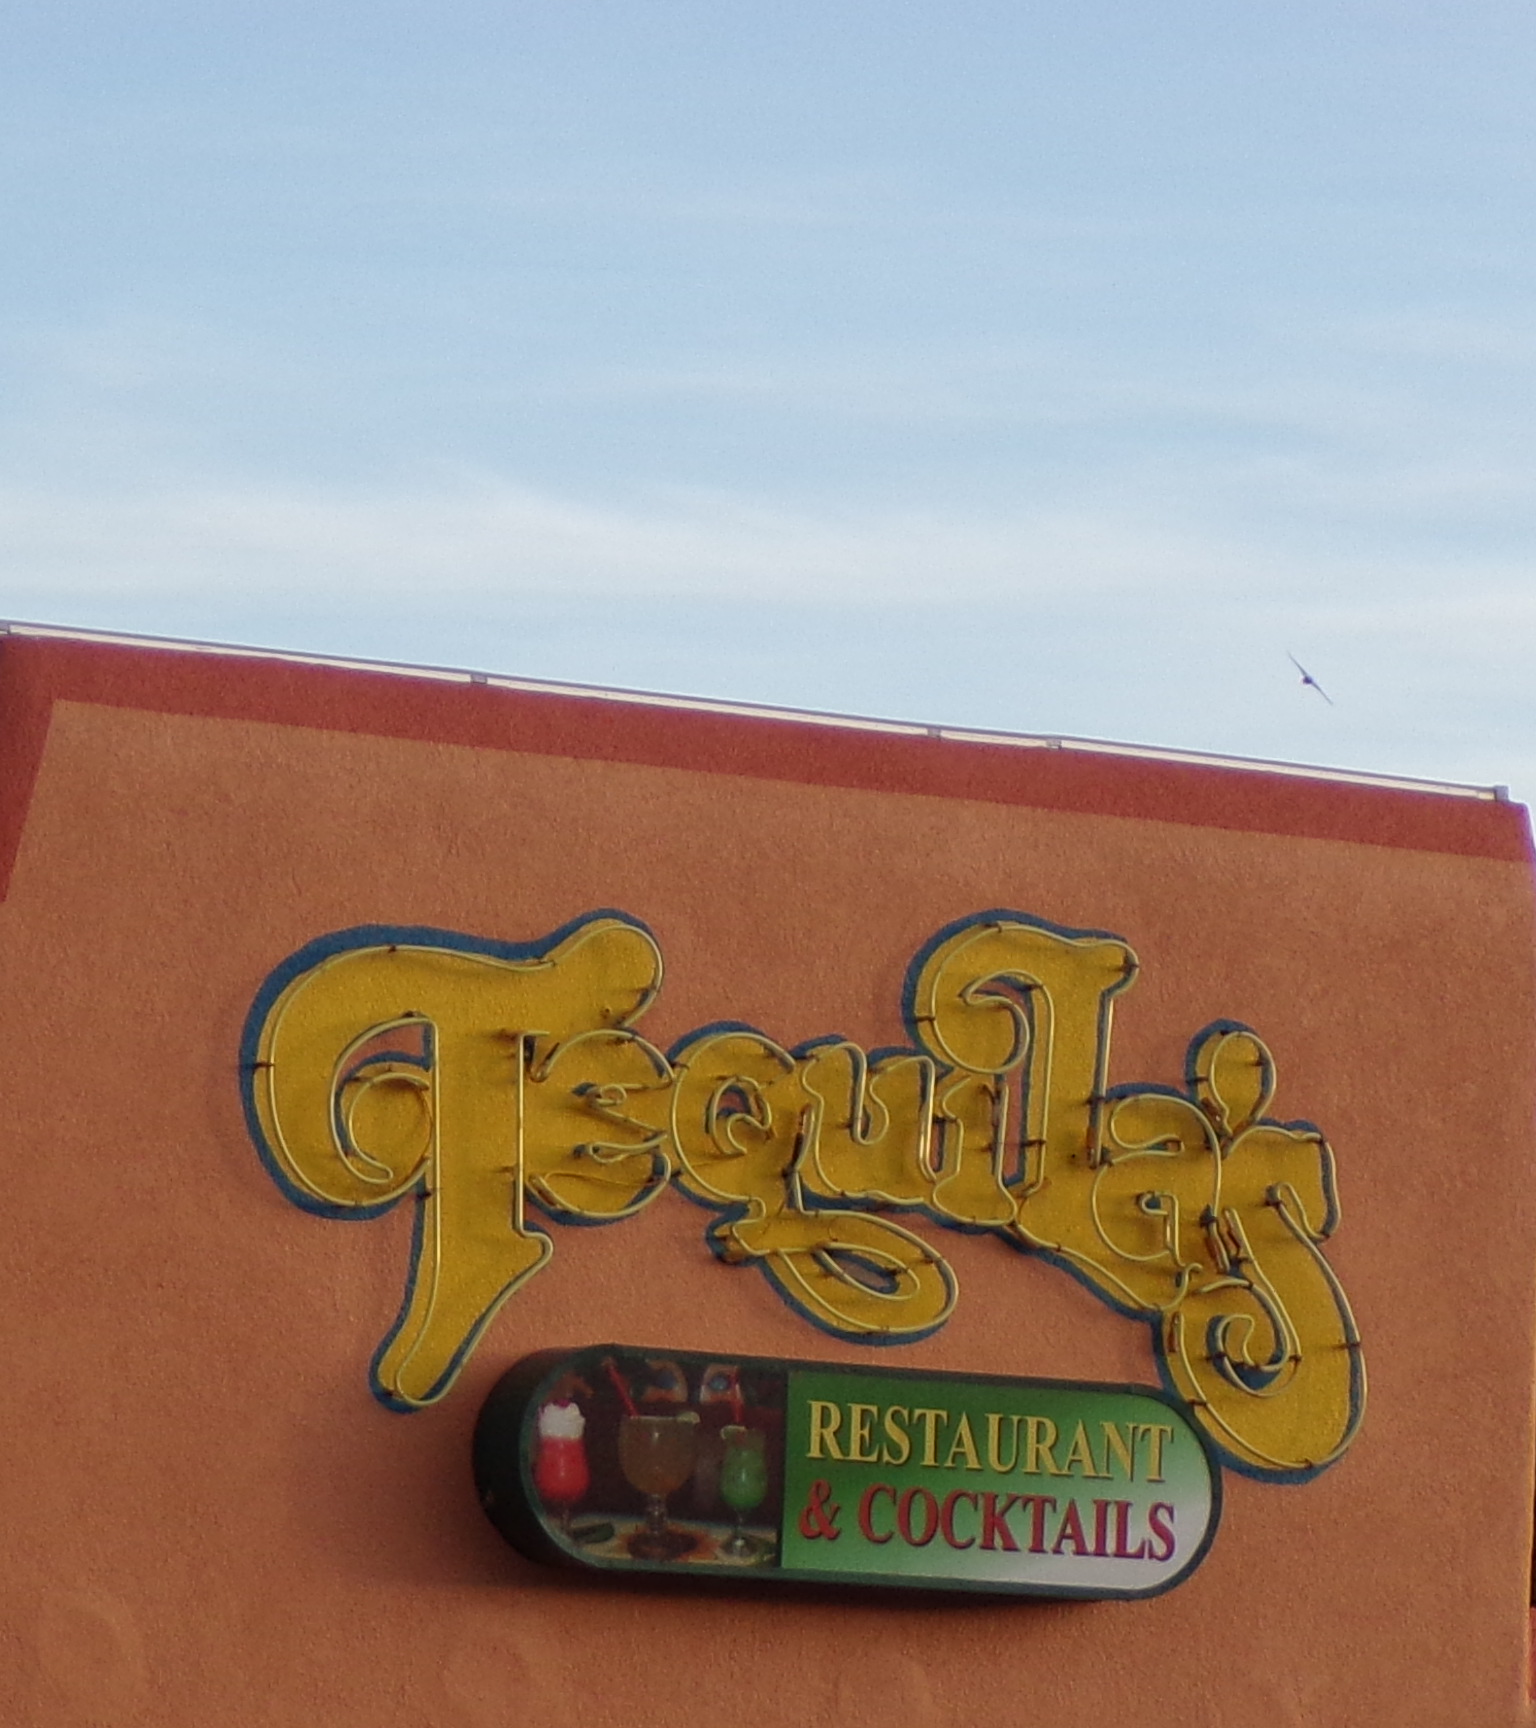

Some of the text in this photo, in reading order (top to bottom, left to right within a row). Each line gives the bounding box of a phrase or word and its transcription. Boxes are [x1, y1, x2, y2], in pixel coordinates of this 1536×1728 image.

[242, 910, 1368, 1484] Tequila's
[805, 1400, 1174, 1483] RESTAURANT
[797, 1478, 1177, 1562] & COCKTAILS
